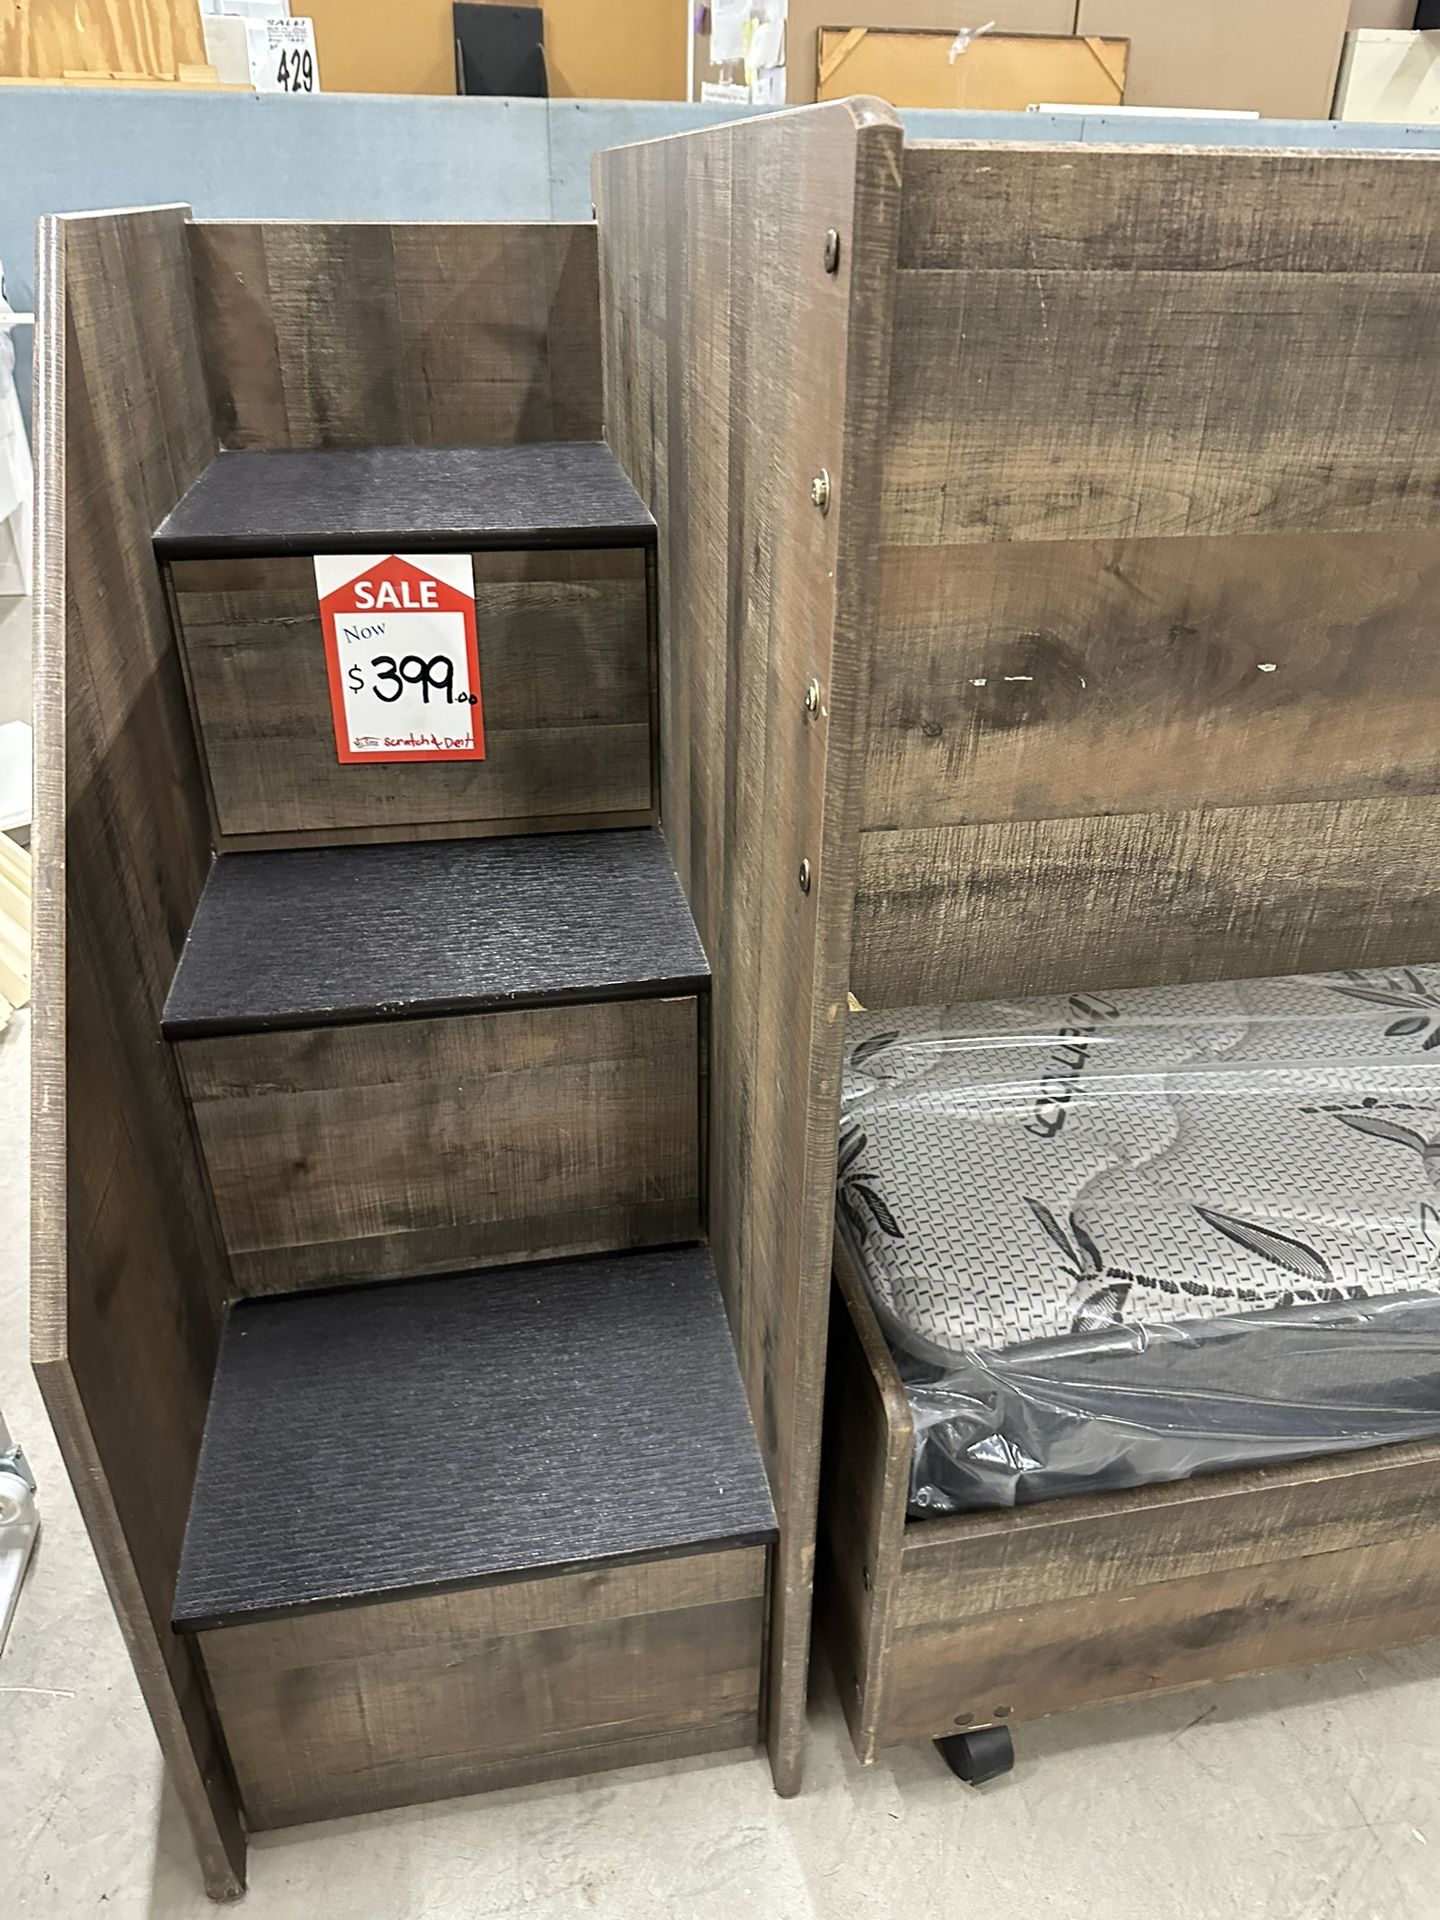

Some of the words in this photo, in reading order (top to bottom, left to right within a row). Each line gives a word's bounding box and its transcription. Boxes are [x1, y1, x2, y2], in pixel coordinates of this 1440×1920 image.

[277, 49, 313, 92] 429
[354, 581, 439, 609] SALE
[444, 732, 474, 748] Dent
